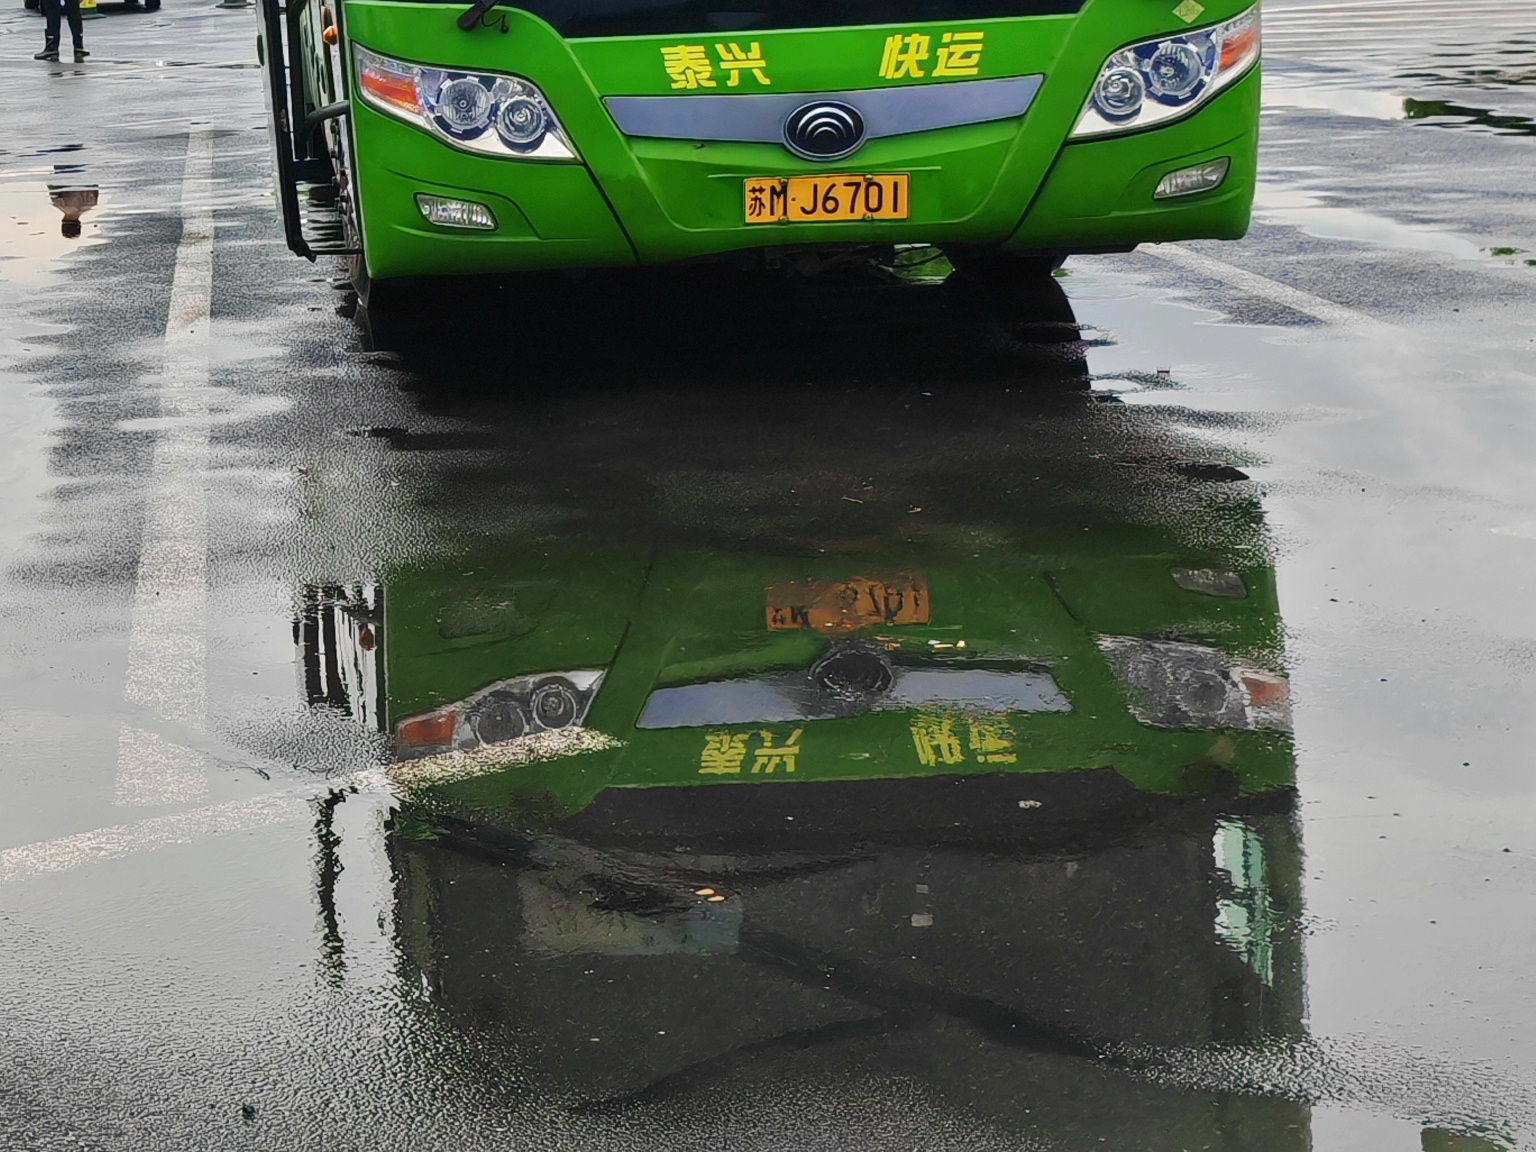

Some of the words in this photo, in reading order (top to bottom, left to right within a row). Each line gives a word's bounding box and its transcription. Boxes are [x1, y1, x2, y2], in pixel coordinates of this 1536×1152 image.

[661, 42, 771, 89] 泰兴
[878, 31, 984, 80] 快运
[748, 181, 901, 219] 苏M·J6701
